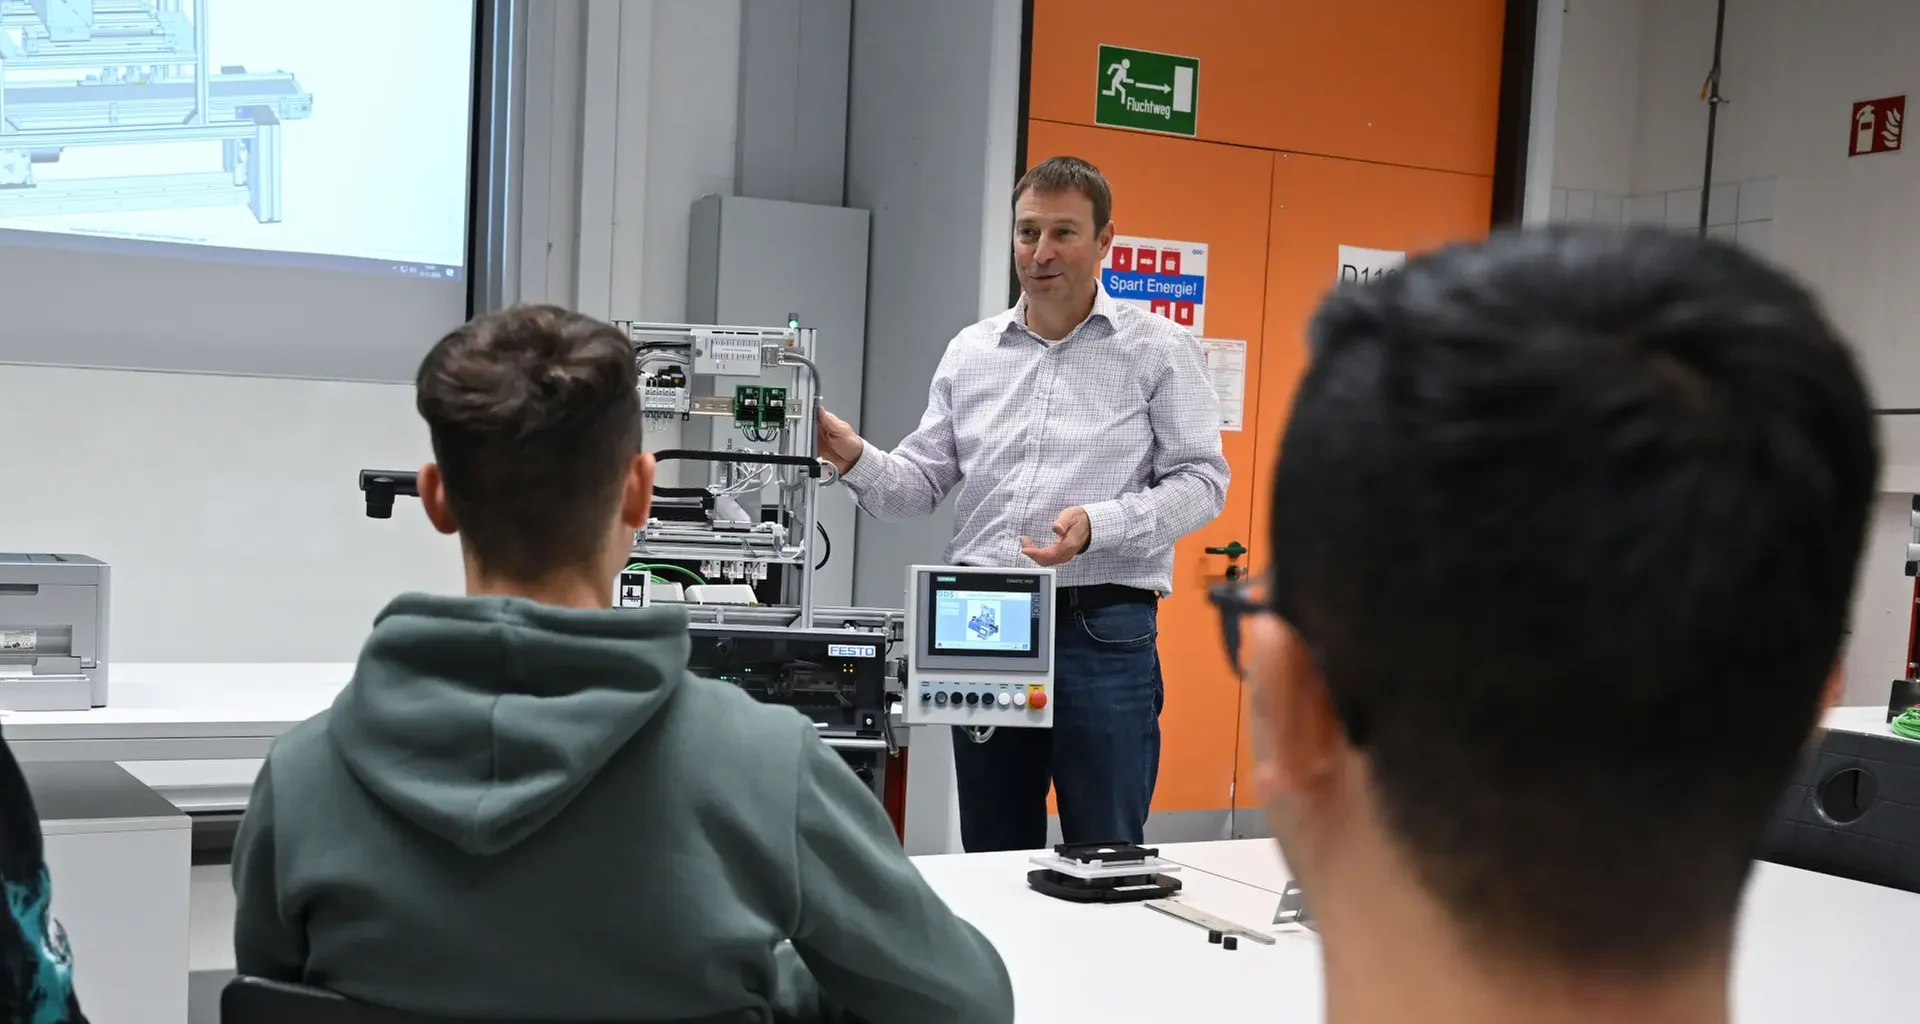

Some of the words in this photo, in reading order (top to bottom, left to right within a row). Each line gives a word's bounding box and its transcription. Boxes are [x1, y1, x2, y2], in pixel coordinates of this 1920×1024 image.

[1126, 97, 1171, 120] Fluchtweg
[1109, 275, 1144, 293] Spart
[1147, 278, 1197, 298] Energie!
[830, 646, 875, 656] FESTO
